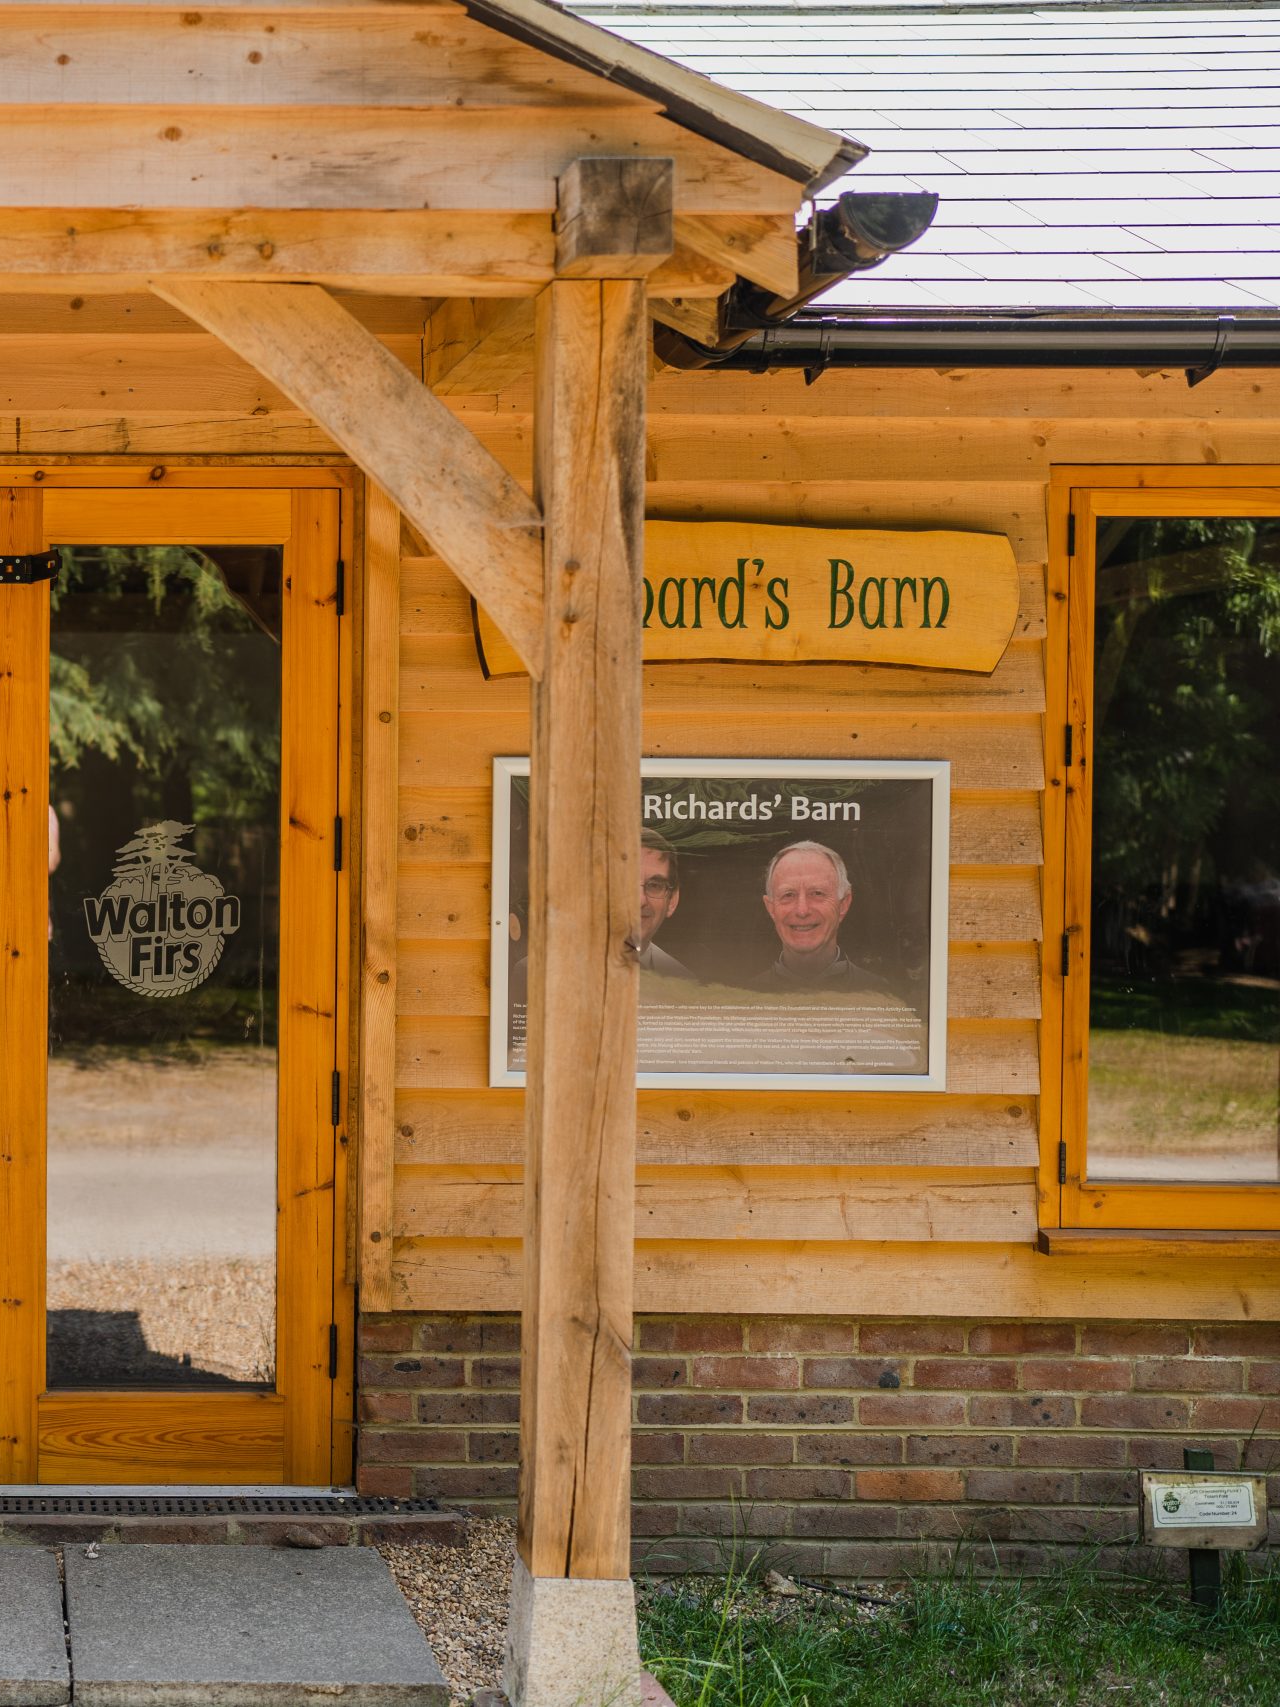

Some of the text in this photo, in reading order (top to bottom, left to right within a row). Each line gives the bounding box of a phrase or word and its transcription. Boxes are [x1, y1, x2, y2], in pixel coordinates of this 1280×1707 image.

[827, 558, 950, 630] Barn
[791, 796, 861, 821] Barn
[84, 892, 239, 938] Walton
[131, 935, 202, 977] Firs
